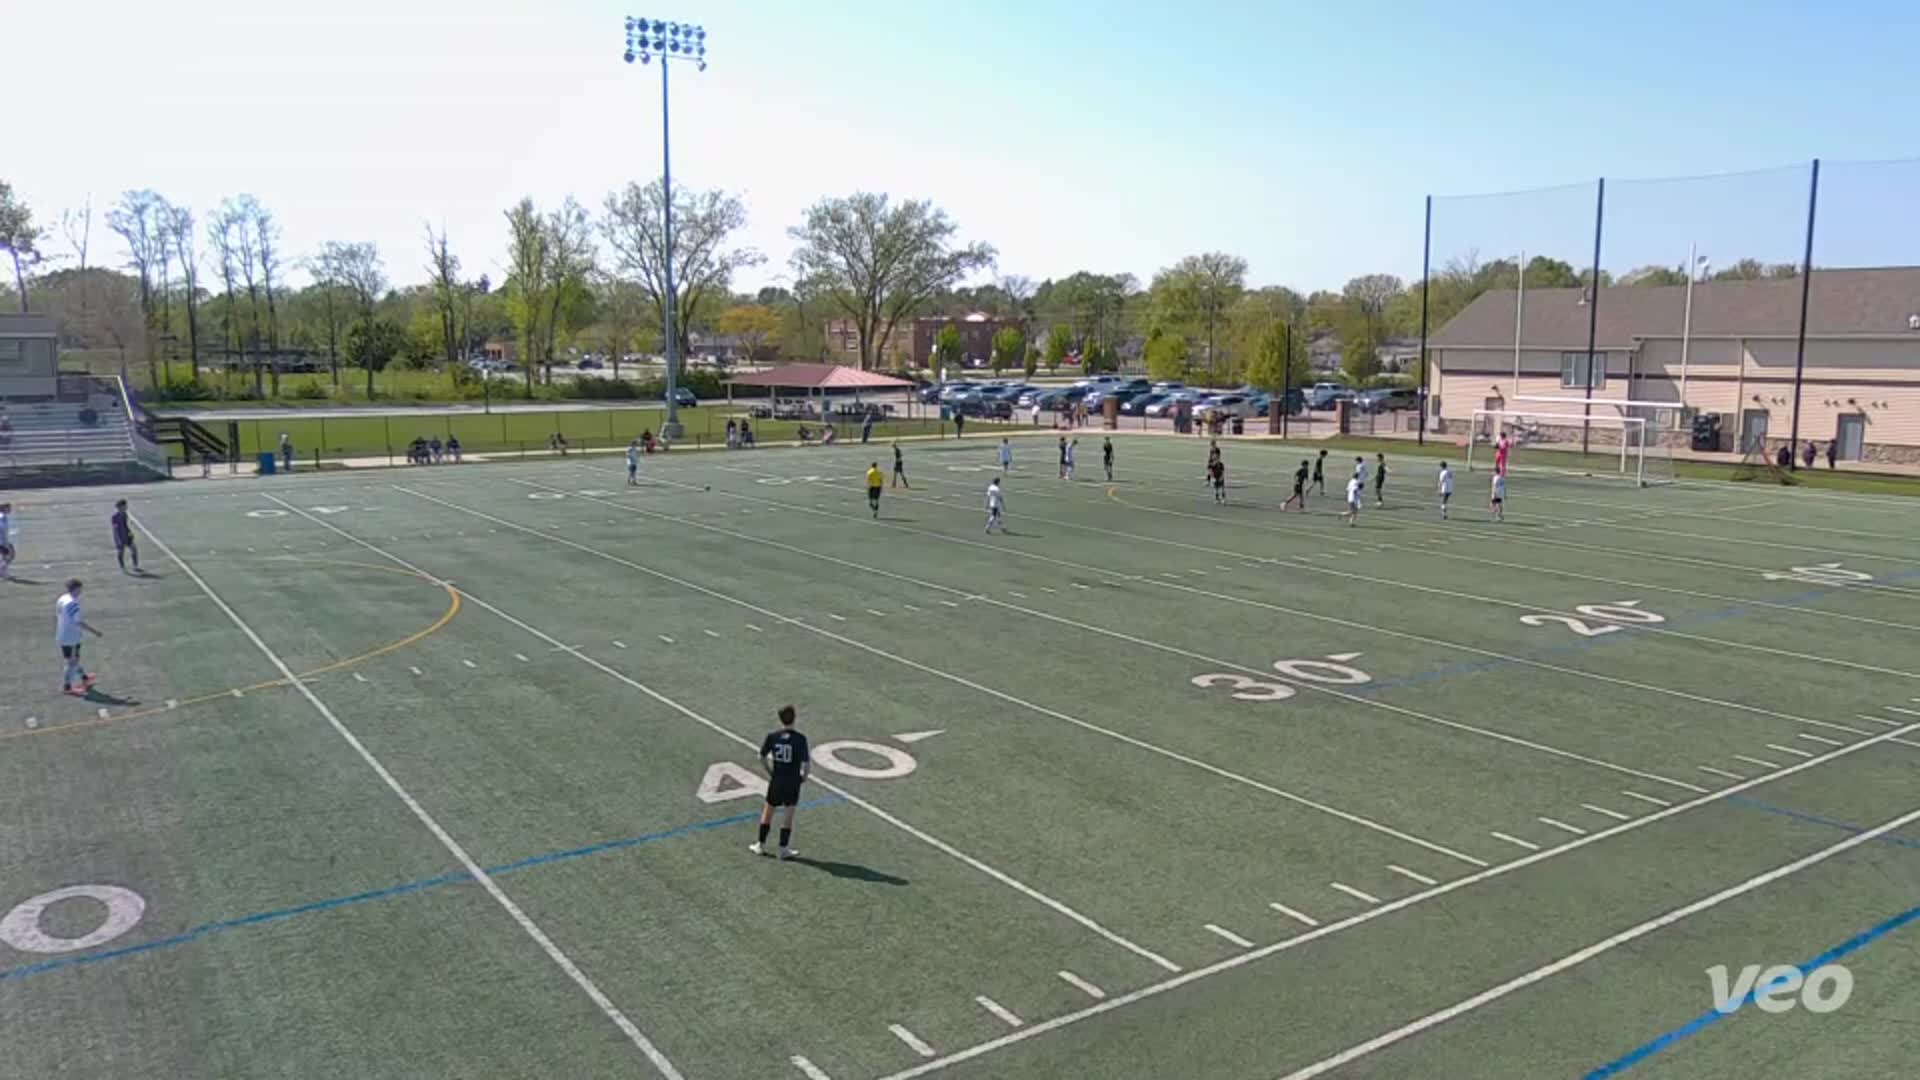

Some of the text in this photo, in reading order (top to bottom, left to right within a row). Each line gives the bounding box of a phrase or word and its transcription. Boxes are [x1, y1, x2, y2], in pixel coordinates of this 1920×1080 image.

[1520, 603, 1666, 637] 20
[1191, 656, 1372, 701] 30
[696, 740, 918, 804] 40
[774, 743, 793, 764] 20
